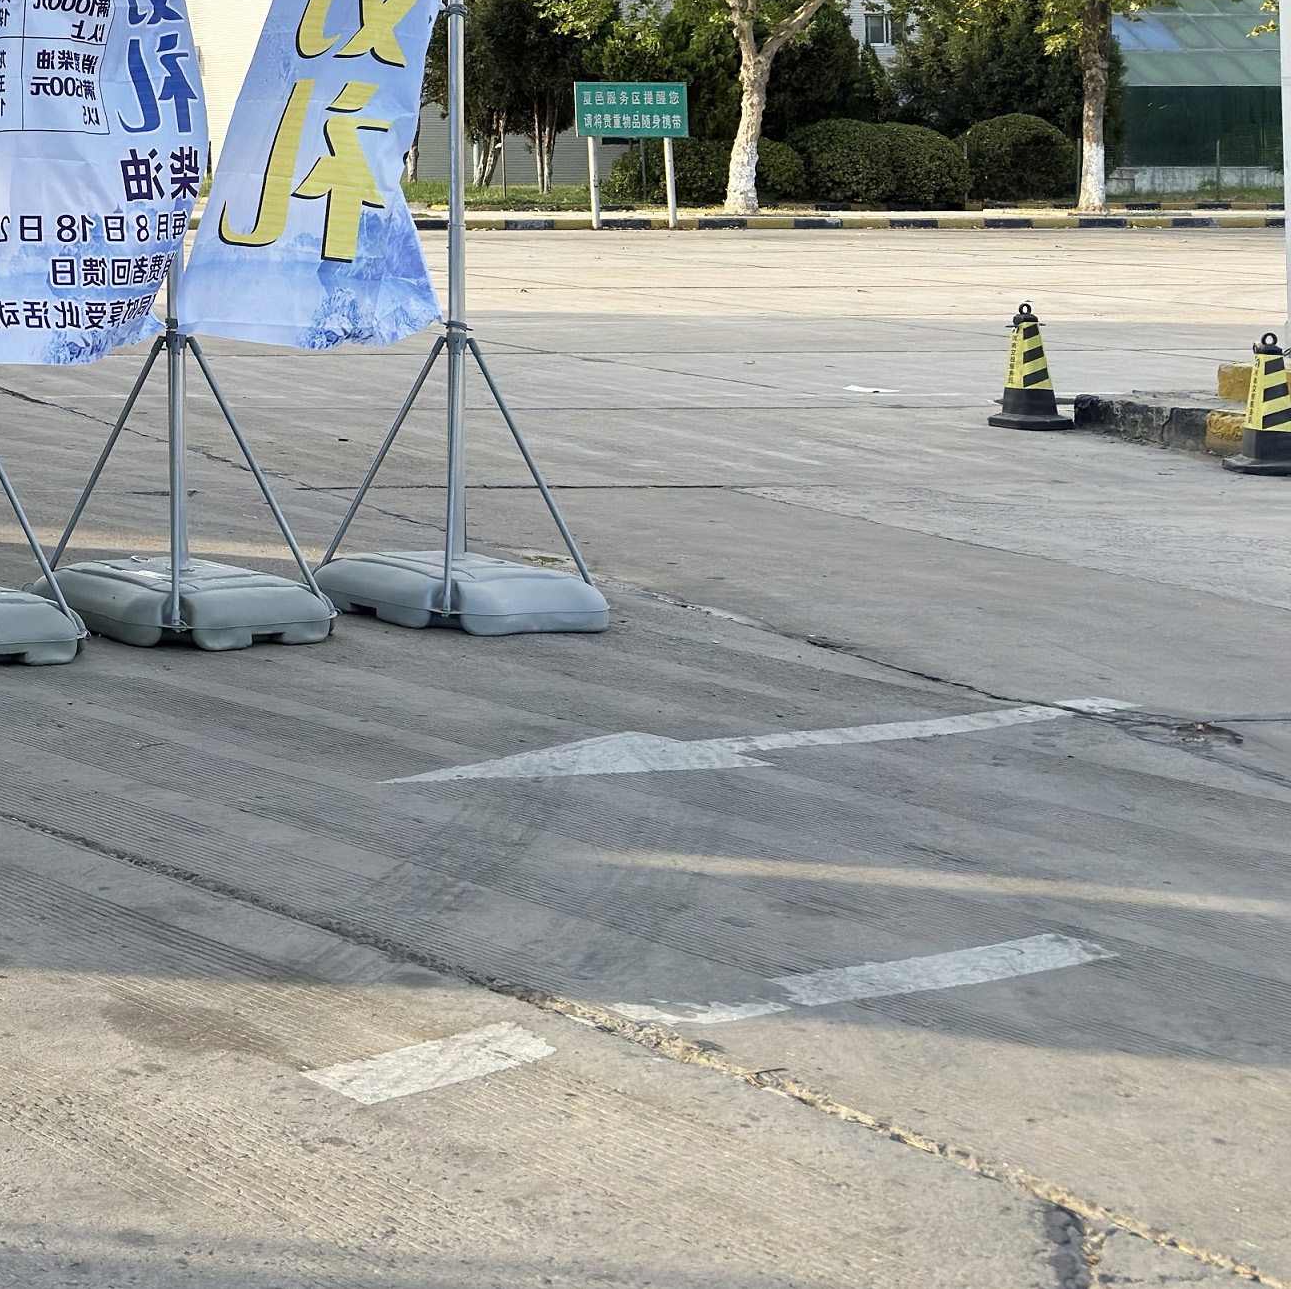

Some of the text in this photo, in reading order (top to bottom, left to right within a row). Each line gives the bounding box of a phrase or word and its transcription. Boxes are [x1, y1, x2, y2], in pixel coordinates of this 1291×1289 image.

[583, 91, 680, 105] 夏邑服务区提醒您
[584, 113, 682, 129] 请将贵重物品随身携带
